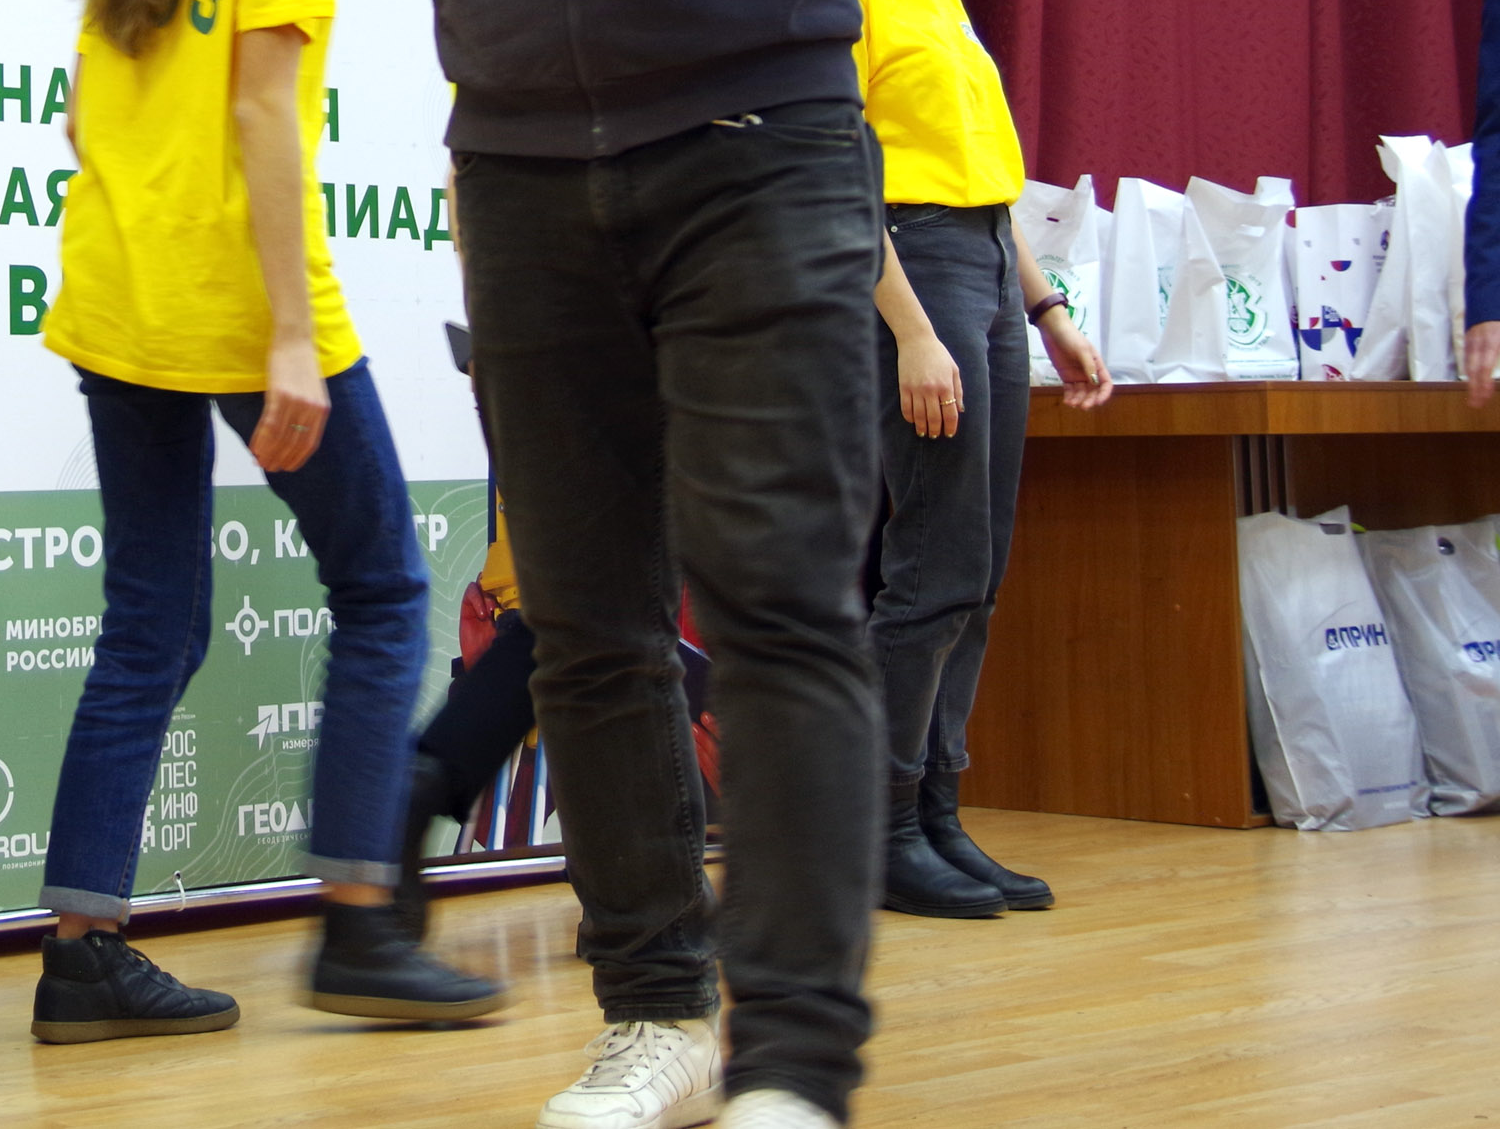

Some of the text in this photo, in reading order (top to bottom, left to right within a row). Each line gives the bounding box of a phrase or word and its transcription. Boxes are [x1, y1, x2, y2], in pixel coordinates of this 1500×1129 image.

[5, 615, 104, 641] МИНОБР
[1338, 623, 1388, 649] ПРИН
[6, 646, 96, 672] РОССИИ
[160, 729, 197, 759] РОС
[160, 760, 197, 790] ЛЕС
[160, 791, 198, 820] ИНФ
[161, 822, 197, 852] ОРГ
